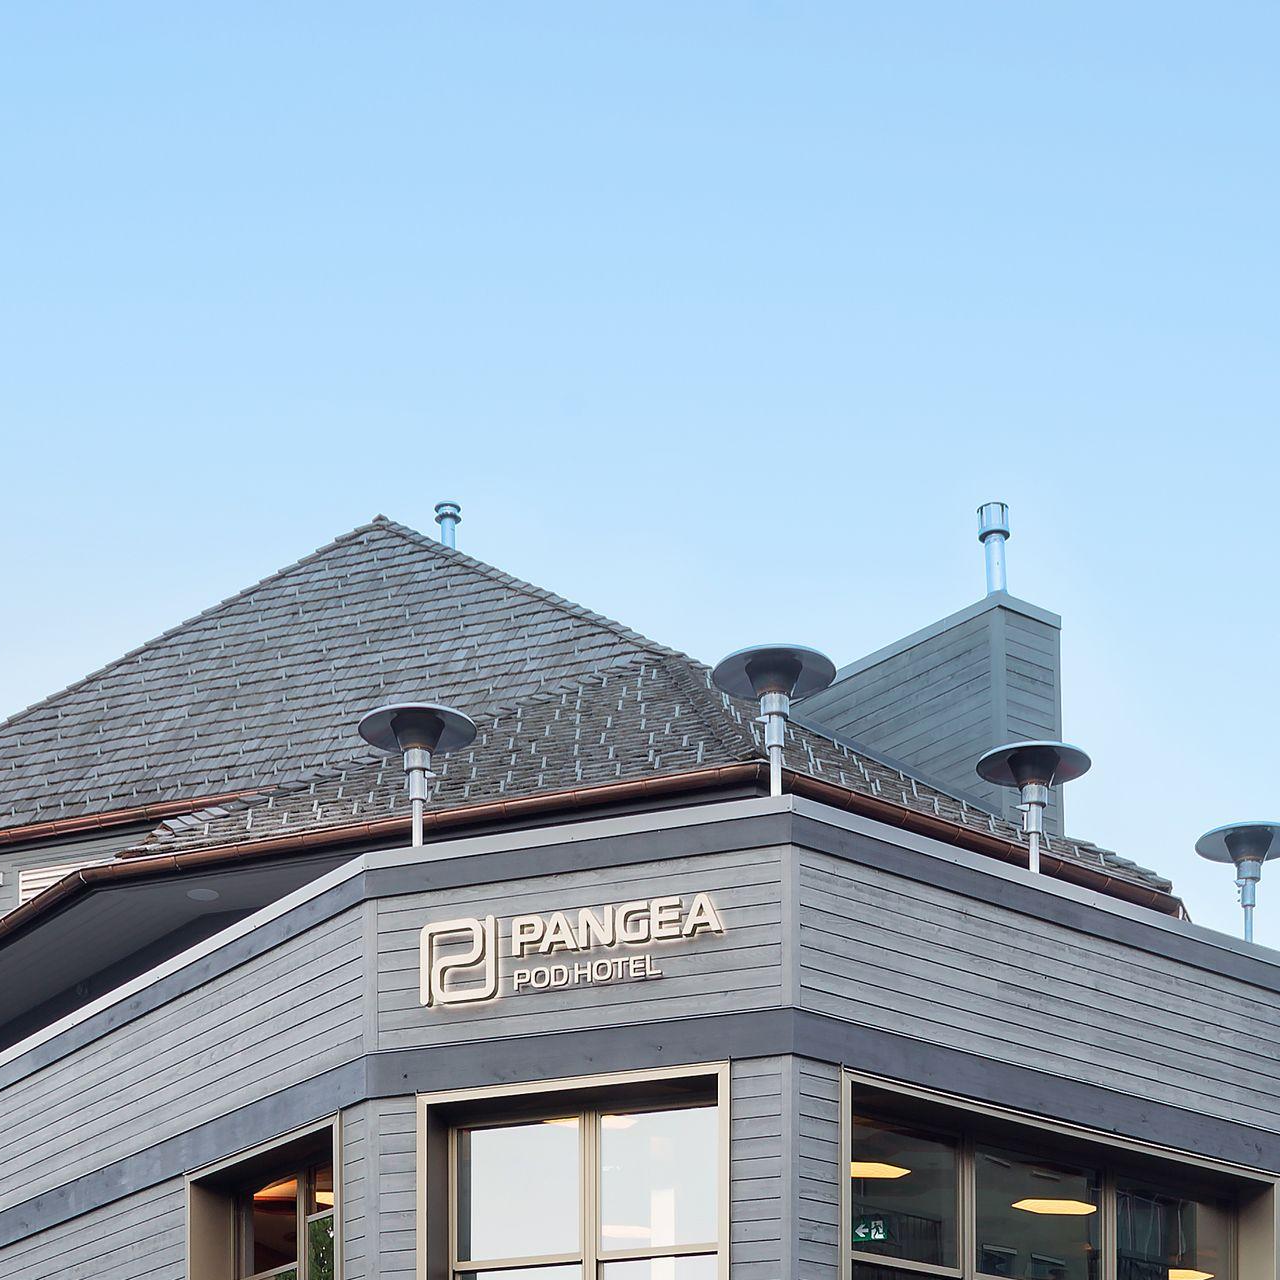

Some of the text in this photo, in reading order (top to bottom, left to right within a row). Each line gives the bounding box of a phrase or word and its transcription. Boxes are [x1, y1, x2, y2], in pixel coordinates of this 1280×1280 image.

[511, 893, 723, 957] PANGEA
[513, 955, 663, 992] POD HOTEL
